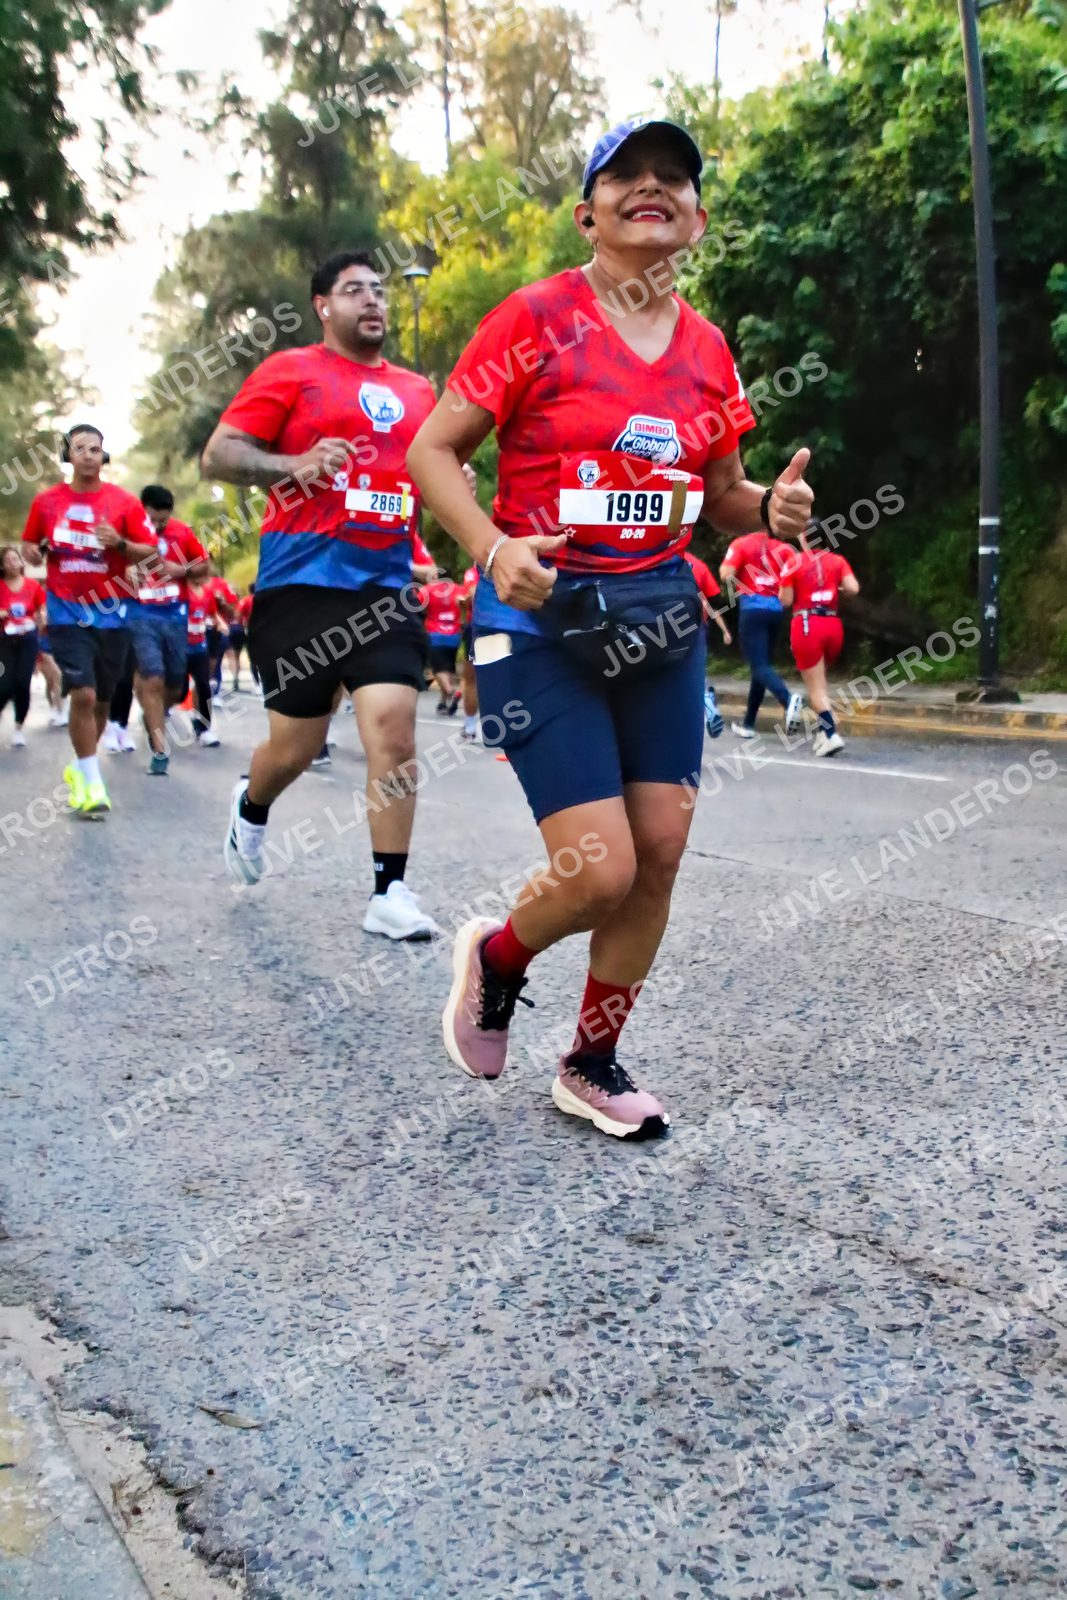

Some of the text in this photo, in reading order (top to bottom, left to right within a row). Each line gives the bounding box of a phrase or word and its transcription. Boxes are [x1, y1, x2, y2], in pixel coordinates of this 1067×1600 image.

[635, 423, 670, 436] BIMBO
[632, 437, 668, 453] Global
[371, 493, 402, 513] 2869
[606, 492, 664, 522] 1999
